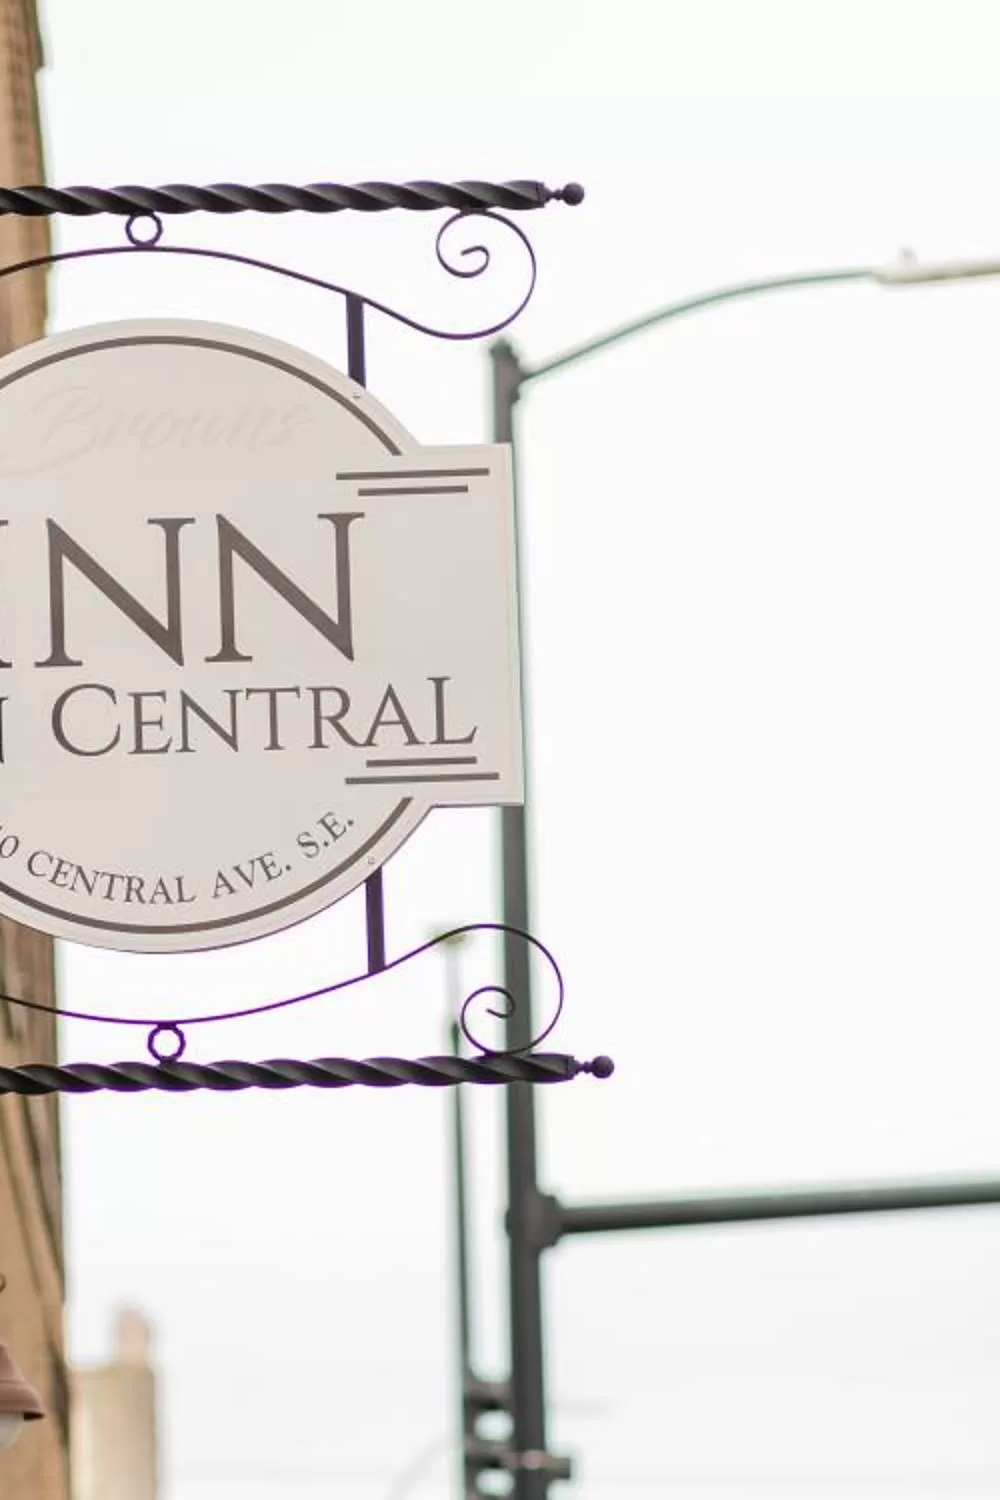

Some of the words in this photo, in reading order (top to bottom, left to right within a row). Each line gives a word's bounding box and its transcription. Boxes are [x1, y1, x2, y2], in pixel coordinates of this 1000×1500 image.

[50, 675, 479, 757] CENTRAL
[26, 849, 197, 905] CENTRAL
[210, 850, 293, 899] AVE.
[295, 810, 356, 860] S.E.
